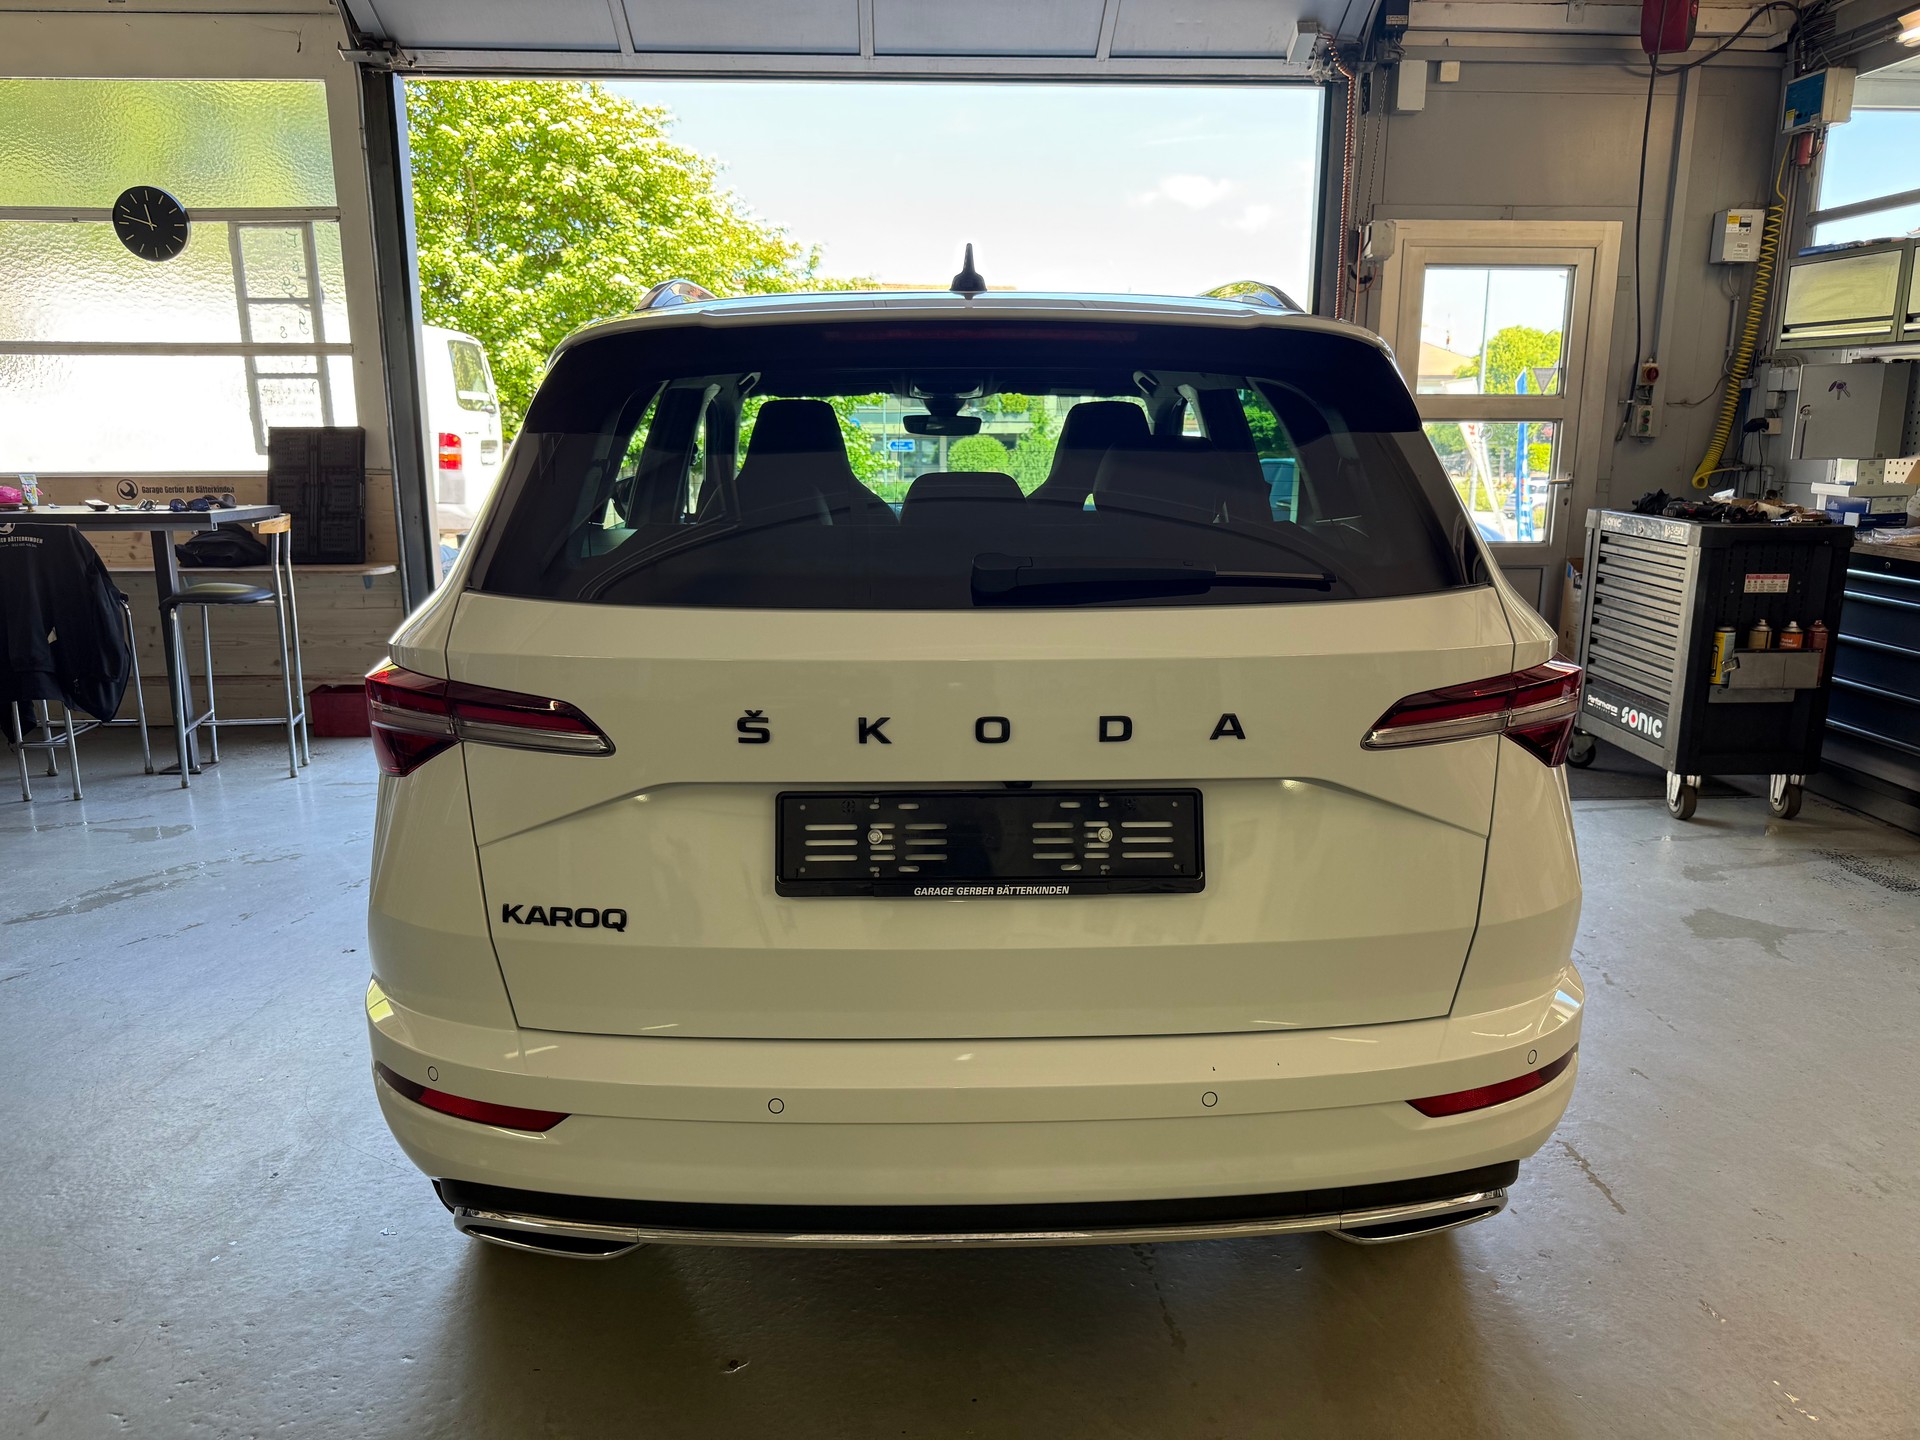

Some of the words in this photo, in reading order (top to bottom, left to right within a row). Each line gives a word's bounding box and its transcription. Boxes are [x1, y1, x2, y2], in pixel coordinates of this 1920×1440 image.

[141, 486, 164, 494] Garage
[164, 486, 185, 494] Gerber
[736, 710, 1247, 745] ŠKODA
[914, 887, 954, 896] GARAGE
[956, 886, 995, 896] GERBER
[997, 884, 1070, 895] BÄTTERKINDEN
[502, 903, 628, 932] KAROQ
